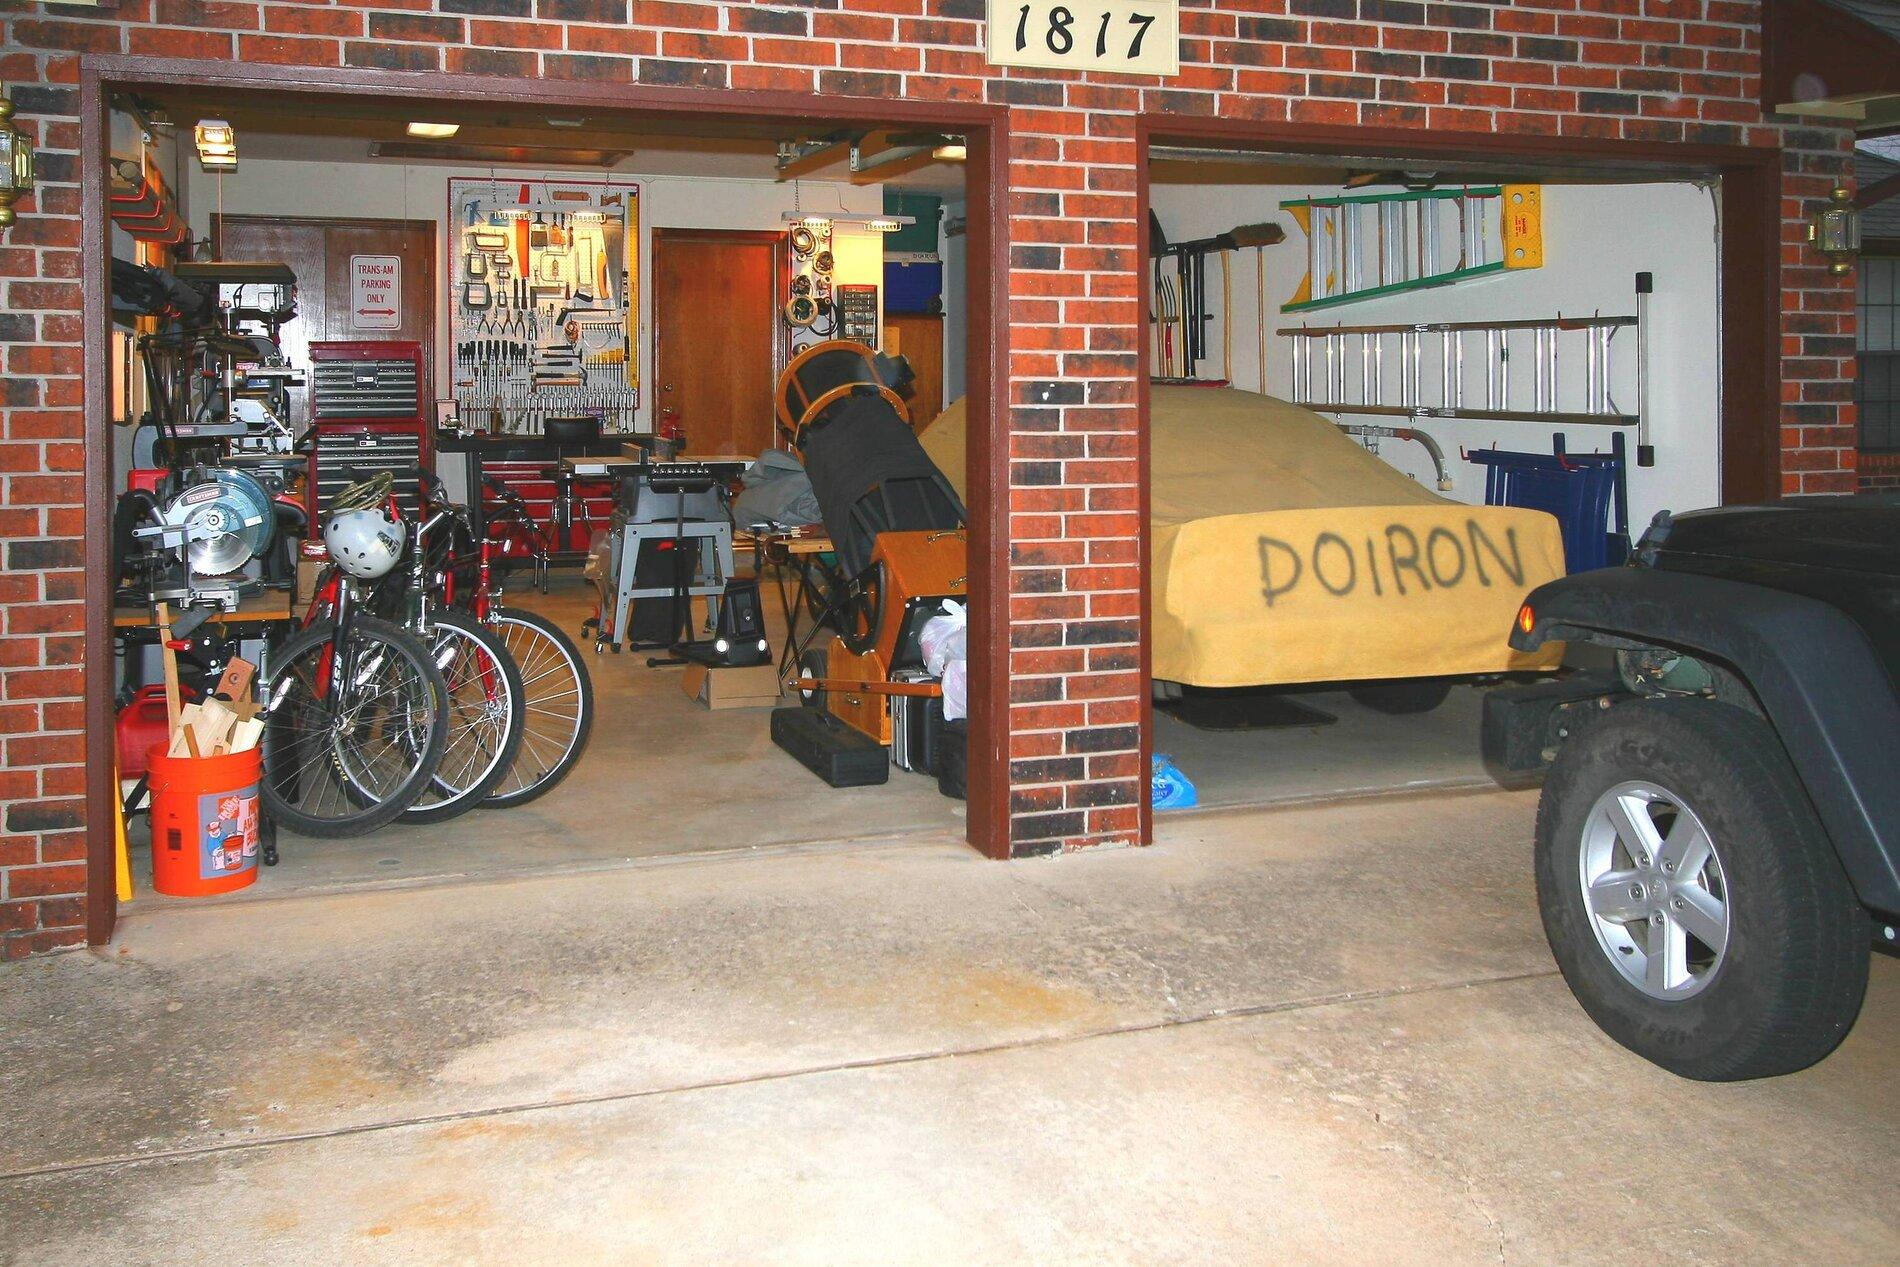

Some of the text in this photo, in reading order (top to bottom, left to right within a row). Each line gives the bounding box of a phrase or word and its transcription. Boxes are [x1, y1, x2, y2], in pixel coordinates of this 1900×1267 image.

[1015, 4, 1156, 59] 1817
[358, 264, 394, 275] TRANS-AM
[361, 279, 391, 289] PARKING
[367, 293, 385, 304] ONLY
[1258, 518, 1525, 608] DOIRON
